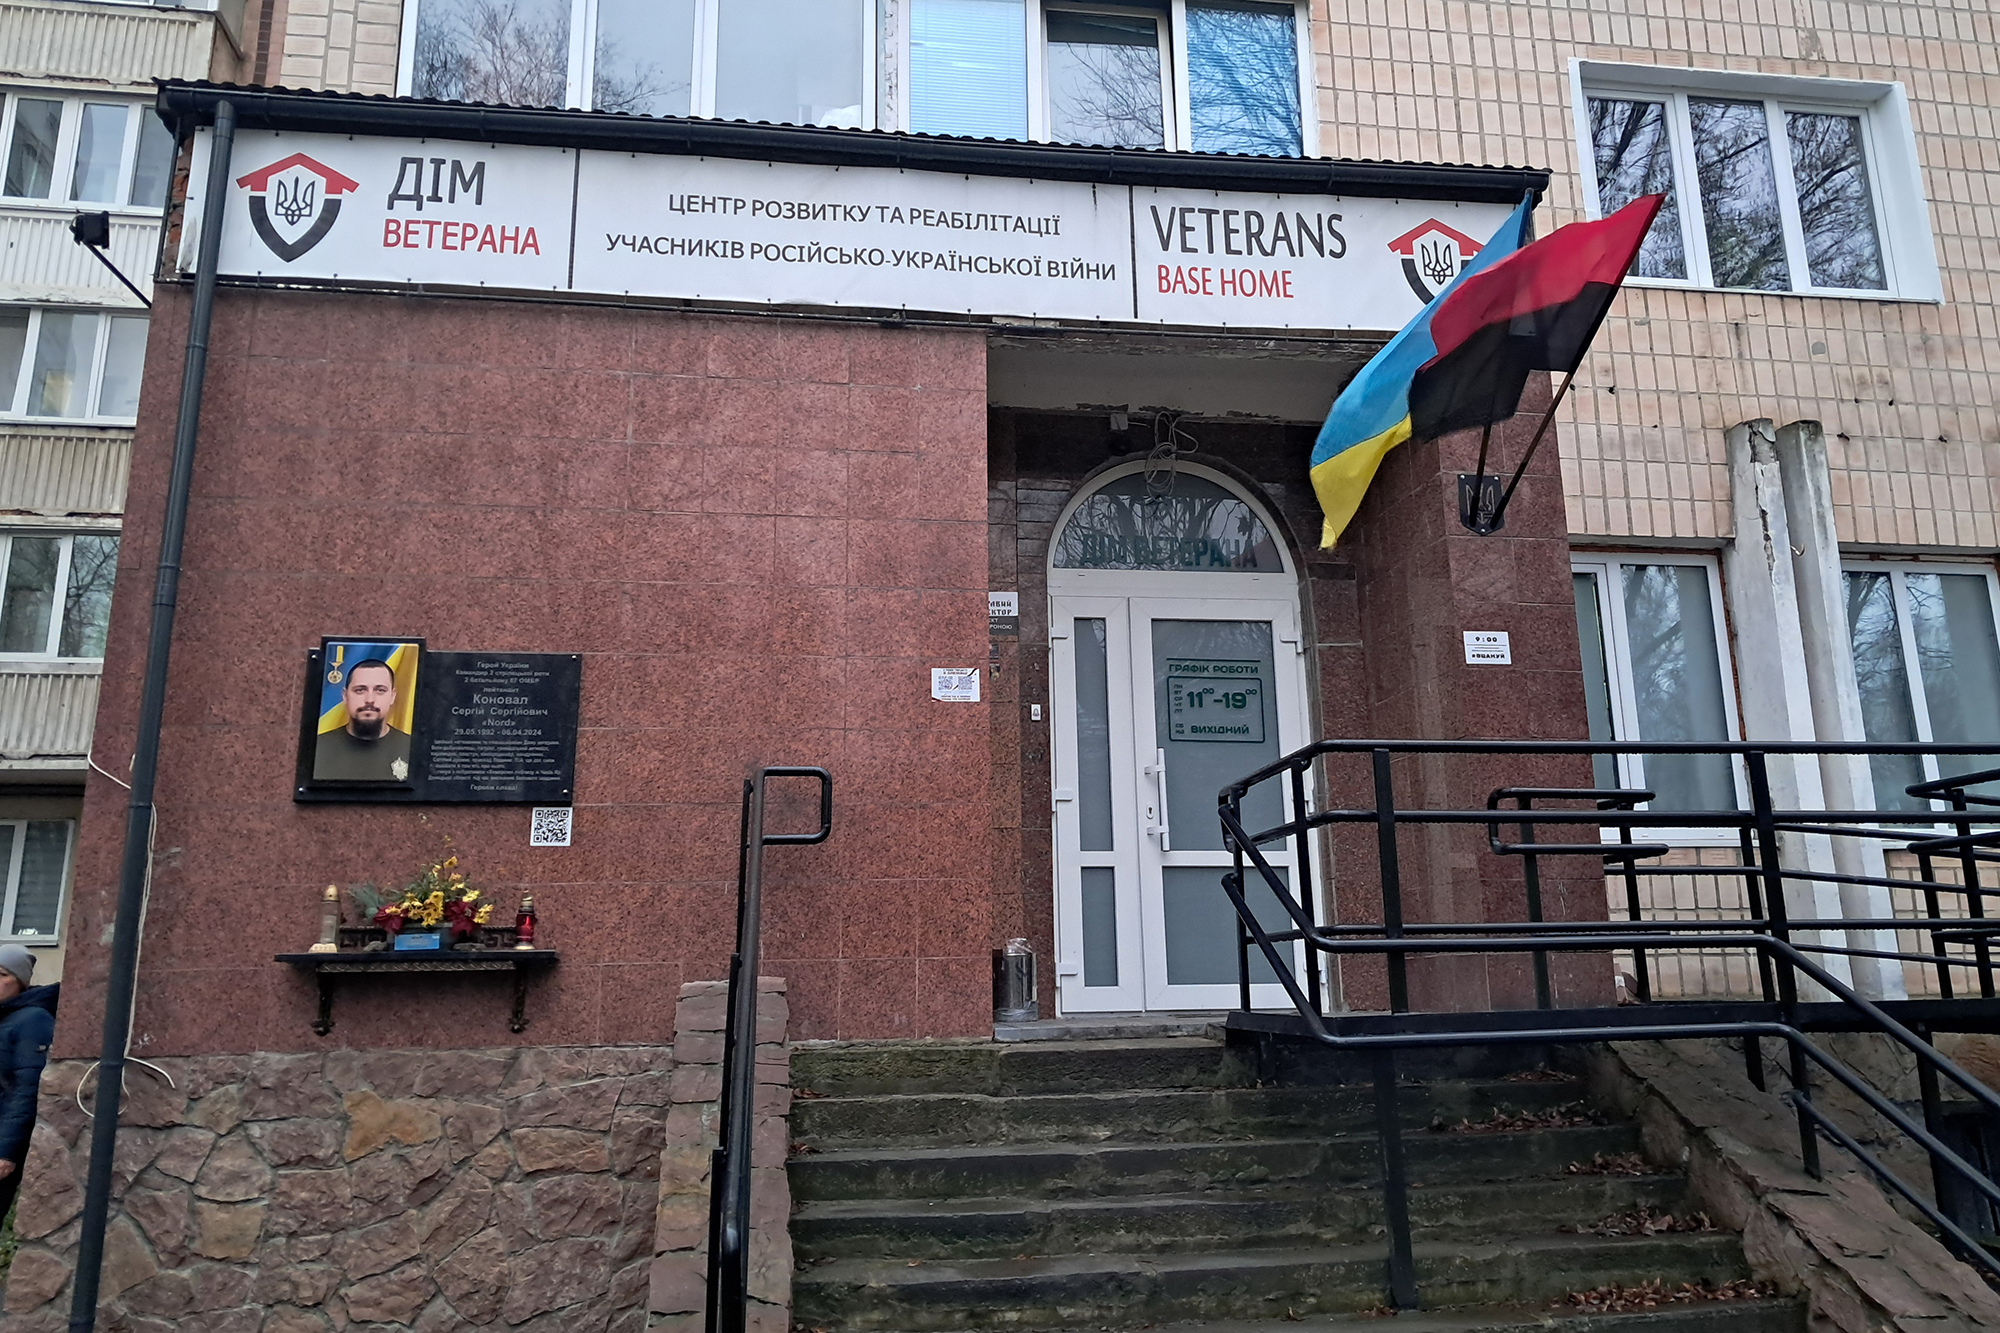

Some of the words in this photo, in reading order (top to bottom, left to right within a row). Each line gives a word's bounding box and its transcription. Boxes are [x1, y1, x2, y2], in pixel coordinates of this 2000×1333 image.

[386, 156, 485, 211] ДІМ
[668, 193, 747, 217] ЦЕНТР
[751, 198, 871, 224] РОЗВИТКУ
[875, 205, 905, 225] ТА
[909, 208, 1061, 239] РЕАБІЛІТАЦІЇ
[1150, 204, 1347, 259] VETERANS
[383, 218, 541, 256] ВЕТЕРАНА
[605, 233, 745, 261] УЧАСНИКІВ
[749, 240, 1043, 278] РОСІЙСЬКО-УКРАЇНСЬКОЇ
[1047, 259, 1117, 281] ВІЙНИ
[1157, 264, 1213, 296] BASE
[1220, 268, 1295, 299] HOME
[1080, 533, 1132, 565] ДІМ
[1135, 535, 1258, 568] ВЕТЕРАНА
[1168, 664, 1210, 673] ГРАФІК
[1213, 665, 1259, 674] РОБОТИ
[451, 706, 485, 716] Сергій
[490, 706, 548, 716] Сергійович
[472, 694, 529, 705] Коновал
[1190, 724, 1250, 734] ВИХІДНИЙ
